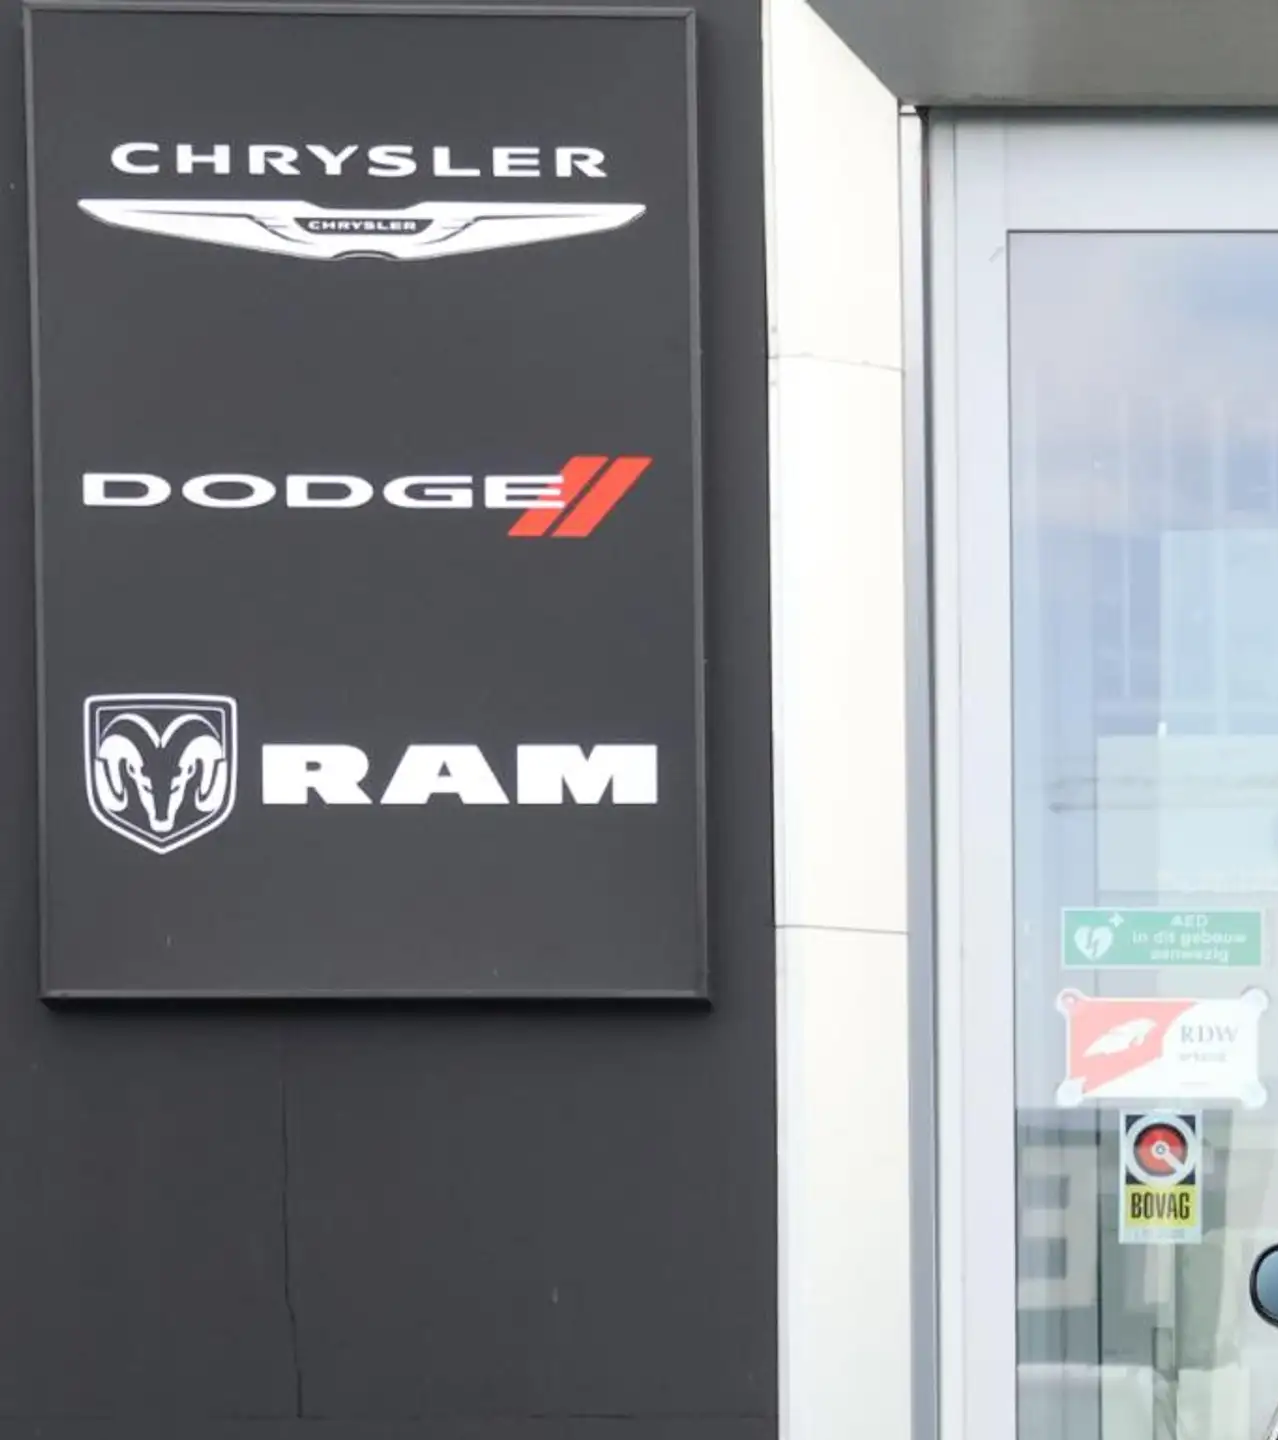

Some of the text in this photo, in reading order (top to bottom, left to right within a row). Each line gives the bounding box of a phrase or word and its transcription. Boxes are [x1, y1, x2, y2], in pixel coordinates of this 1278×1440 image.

[110, 142, 608, 178] CHRYSLER
[307, 219, 417, 232] CHRYSLER
[82, 472, 566, 509] DODGE
[261, 743, 659, 805] RAM
[1169, 913, 1209, 928] AED
[1180, 1024, 1239, 1044] RDW
[1130, 1191, 1191, 1220] BOVAG
